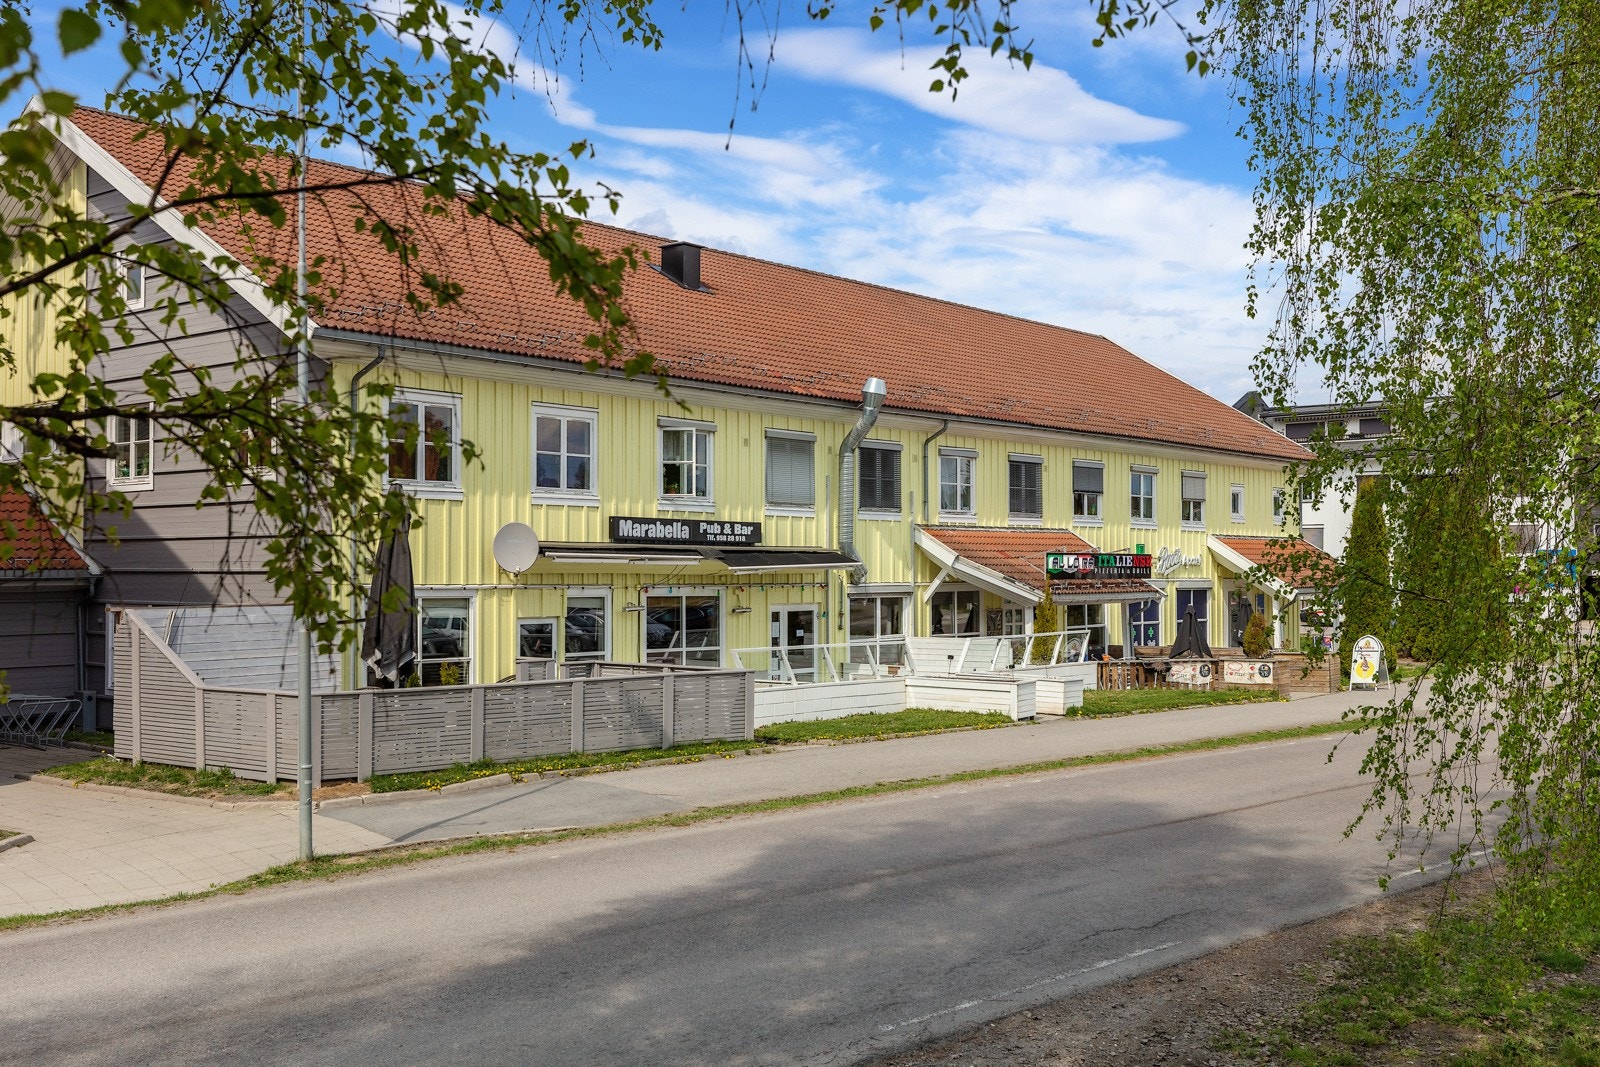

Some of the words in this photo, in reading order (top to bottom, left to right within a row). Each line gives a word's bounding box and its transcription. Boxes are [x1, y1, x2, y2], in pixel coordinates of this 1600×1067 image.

[618, 519, 690, 539] Marabella
[699, 522, 722, 535] Pub
[723, 523, 732, 535] &
[734, 523, 754, 535] Bar
